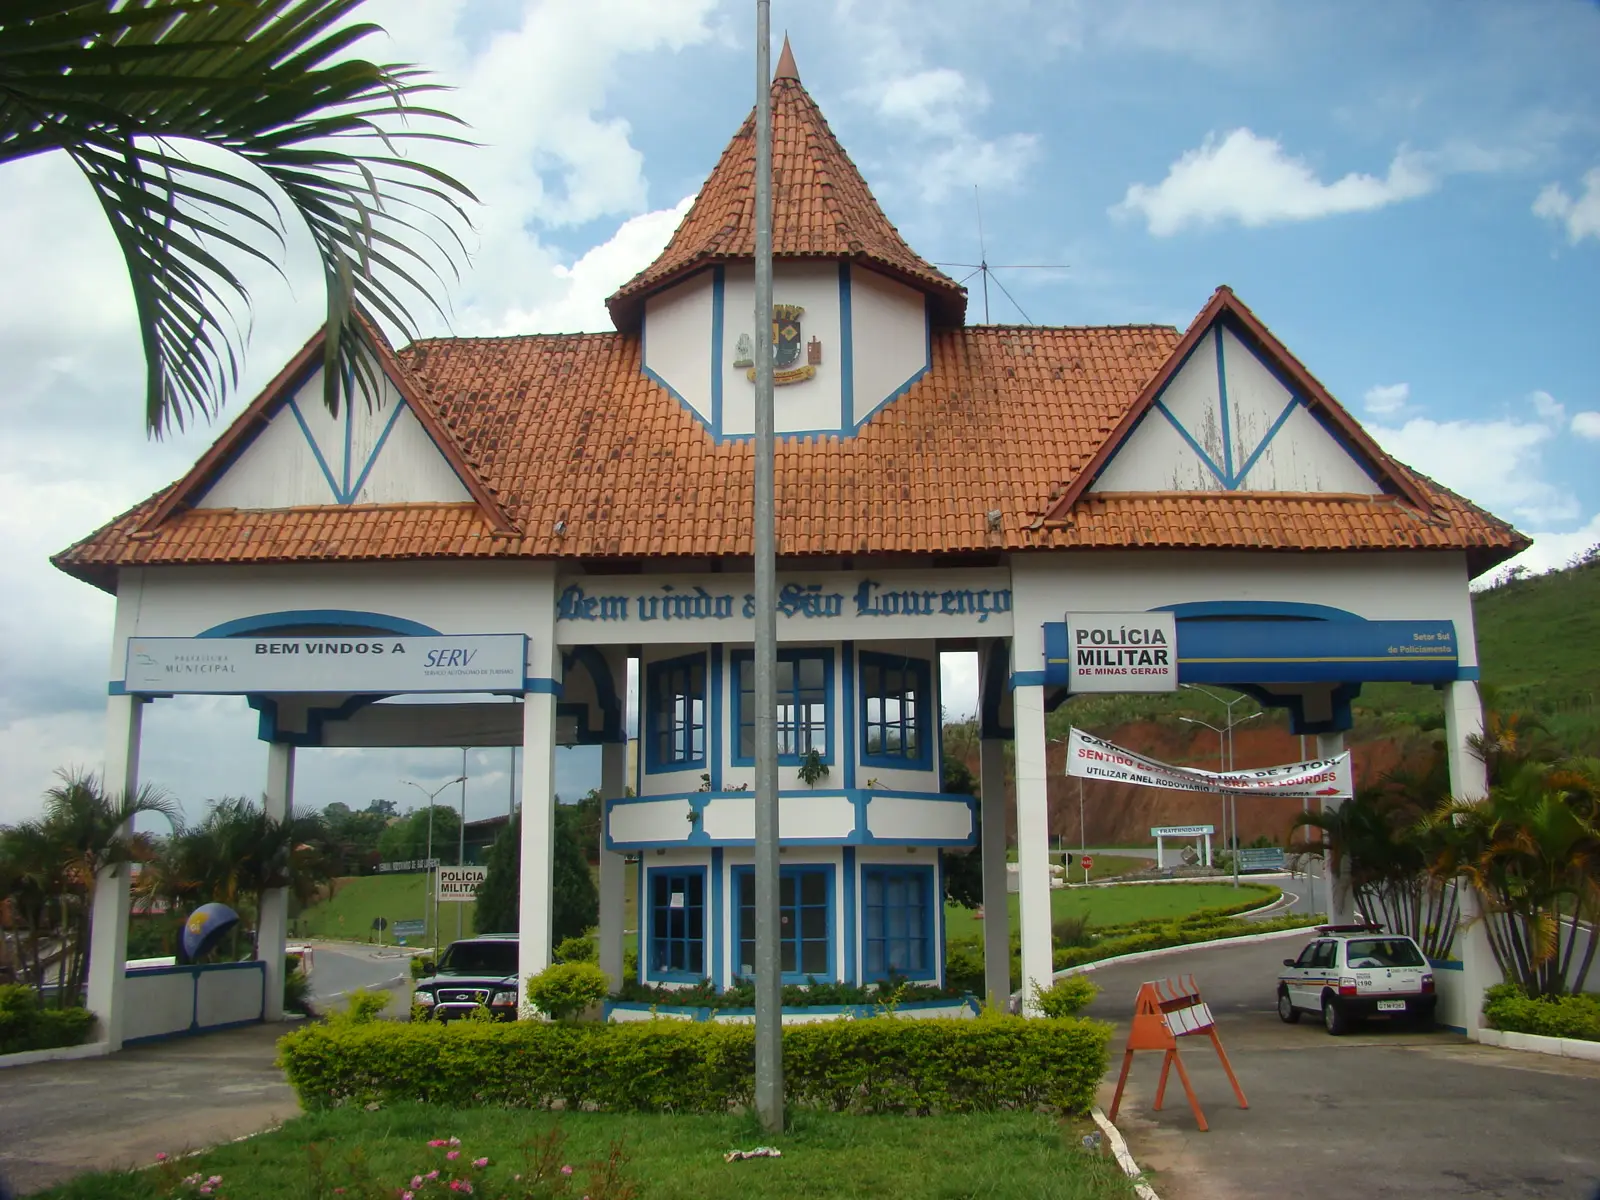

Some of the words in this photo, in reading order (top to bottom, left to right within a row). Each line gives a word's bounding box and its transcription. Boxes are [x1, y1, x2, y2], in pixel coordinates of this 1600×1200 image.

[556, 582, 629, 622] Bem
[776, 582, 845, 618] São
[853, 577, 1012, 623] Lourenço
[1075, 625, 1167, 645] POLÍCIA
[255, 643, 300, 654] BEM
[305, 643, 384, 654] VINDOS
[391, 643, 406, 654] A
[1400, 645, 1452, 653] Policiamento
[423, 649, 478, 668] SERV
[1077, 649, 1169, 666] MILITAR
[165, 664, 237, 673] MUNICIPAL
[1131, 667, 1169, 675] GERAIS
[1078, 748, 1133, 767] SENTIDO
[1279, 772, 1337, 787] LOURDES
[1255, 769, 1276, 777] DE
[1283, 766, 1293, 774] 7
[1086, 766, 1128, 780] UTILIZAR
[1130, 774, 1154, 785] ANEL
[1160, 826, 1204, 834] FRATERNIDADE
[441, 884, 479, 893] MILITA
